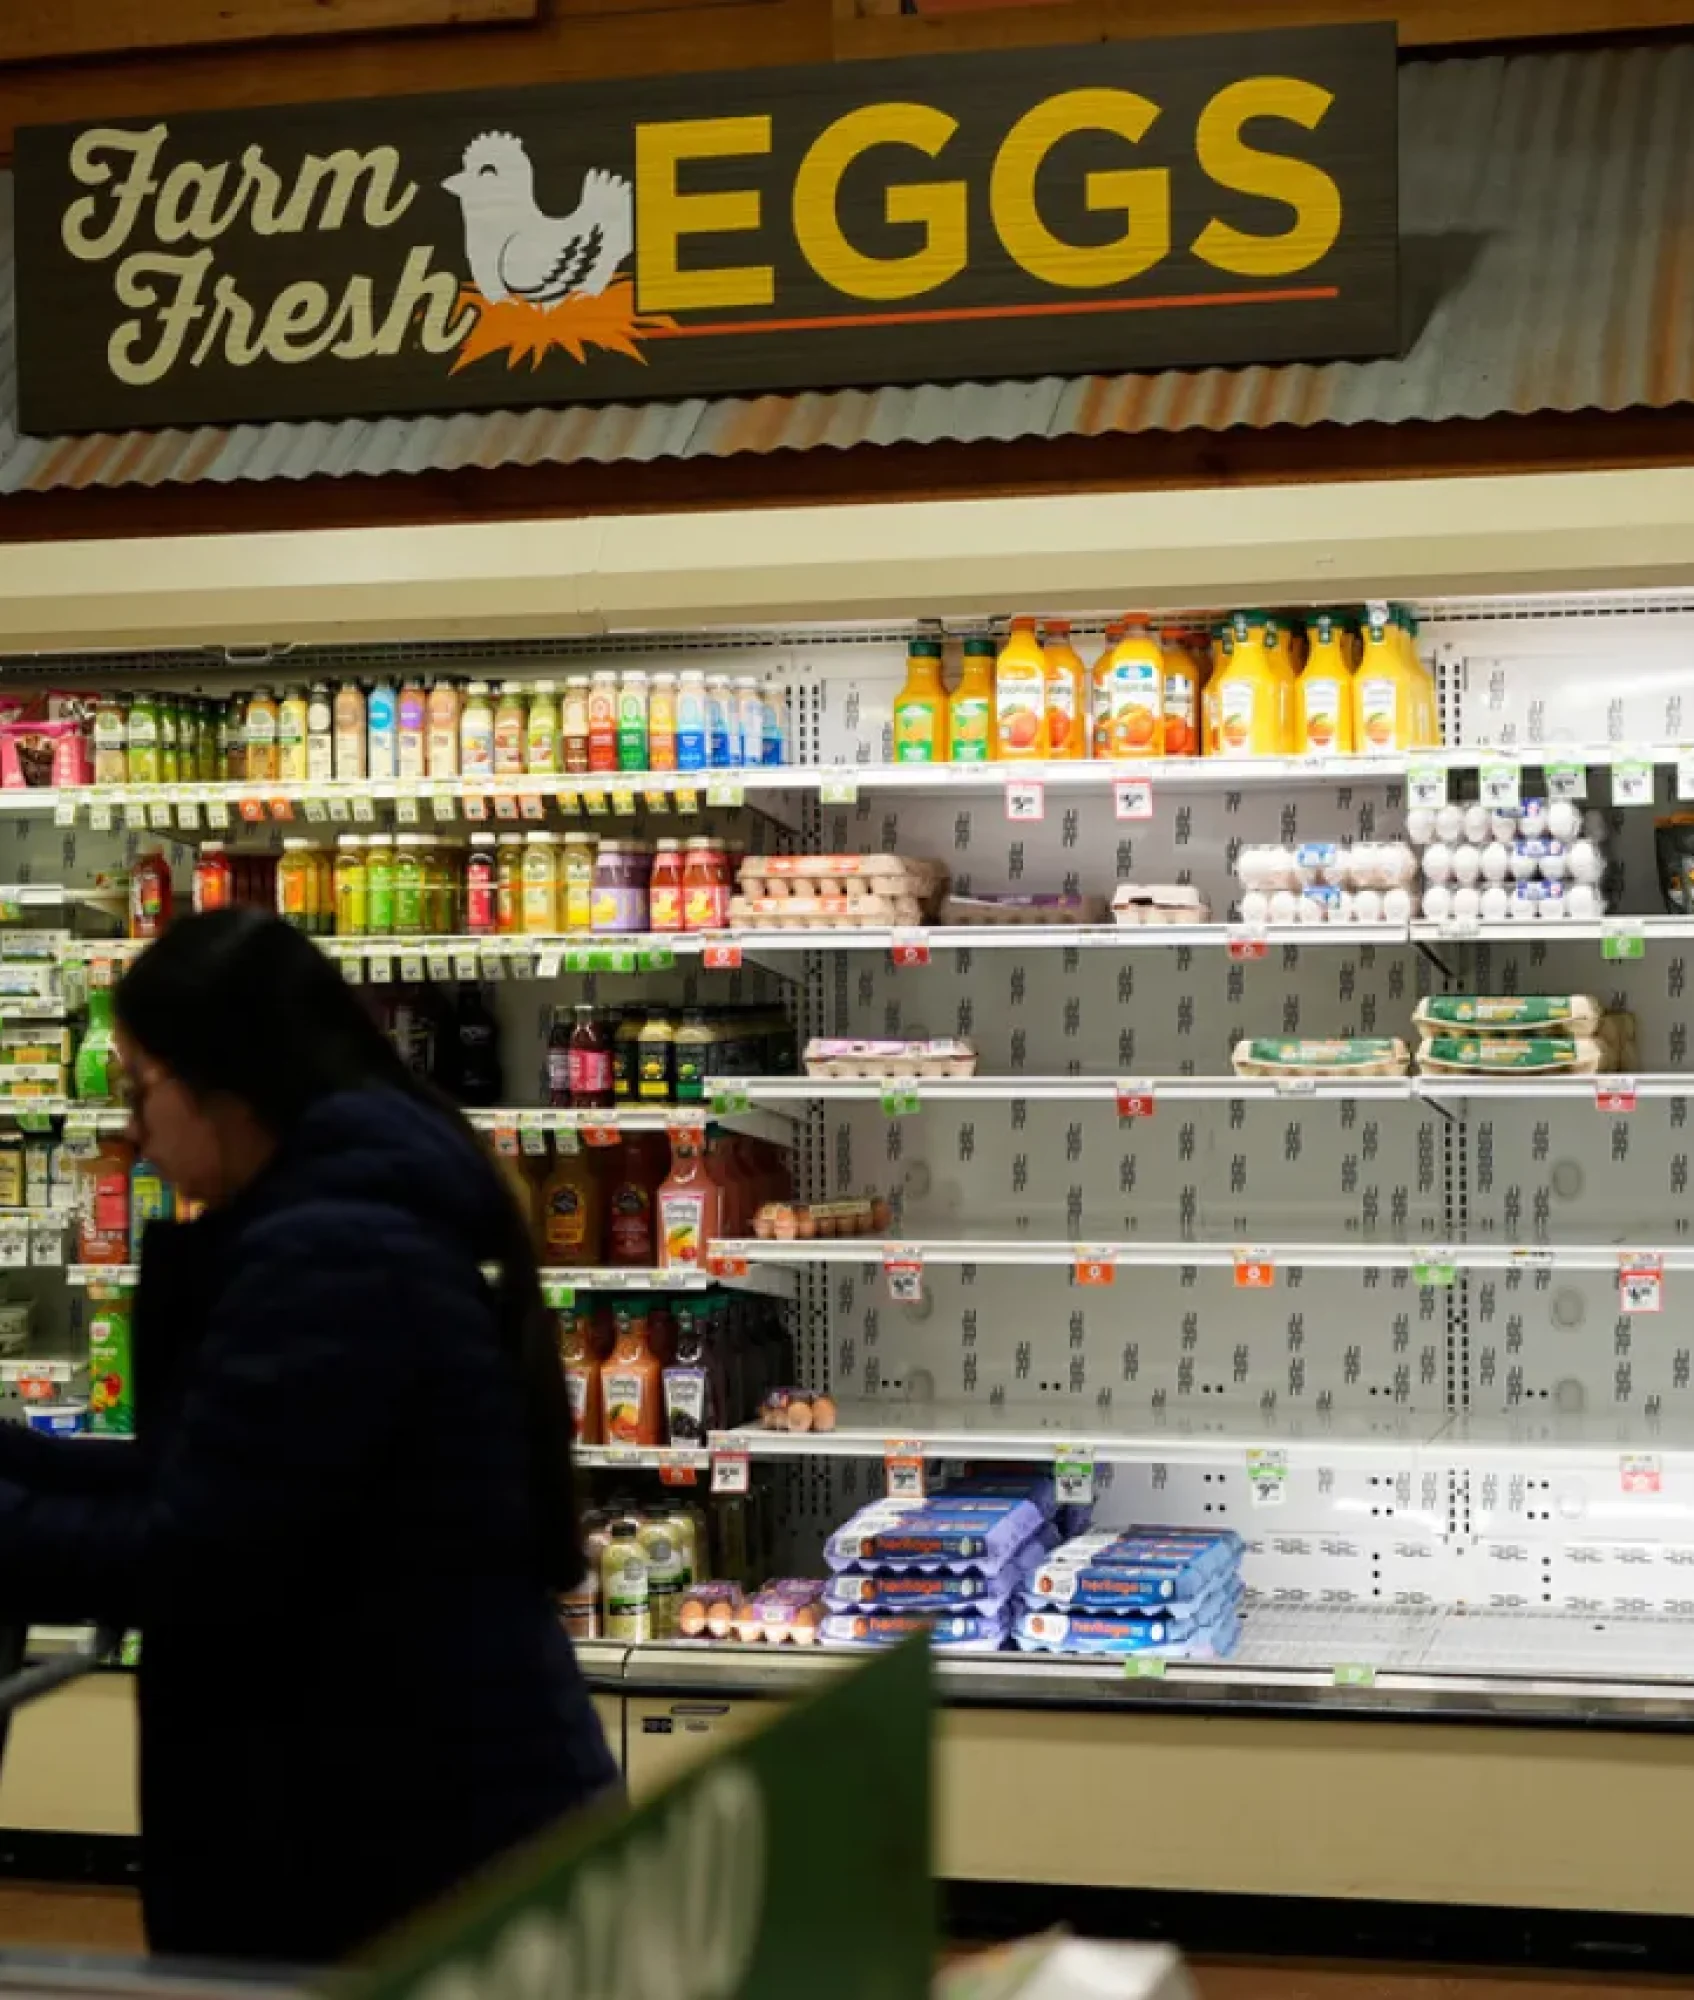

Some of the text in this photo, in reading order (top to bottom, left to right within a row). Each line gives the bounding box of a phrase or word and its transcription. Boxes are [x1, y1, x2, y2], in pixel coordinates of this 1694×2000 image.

[61, 123, 419, 260] Farm
[634, 75, 1342, 312] EGGS
[107, 246, 482, 386] Fresh
